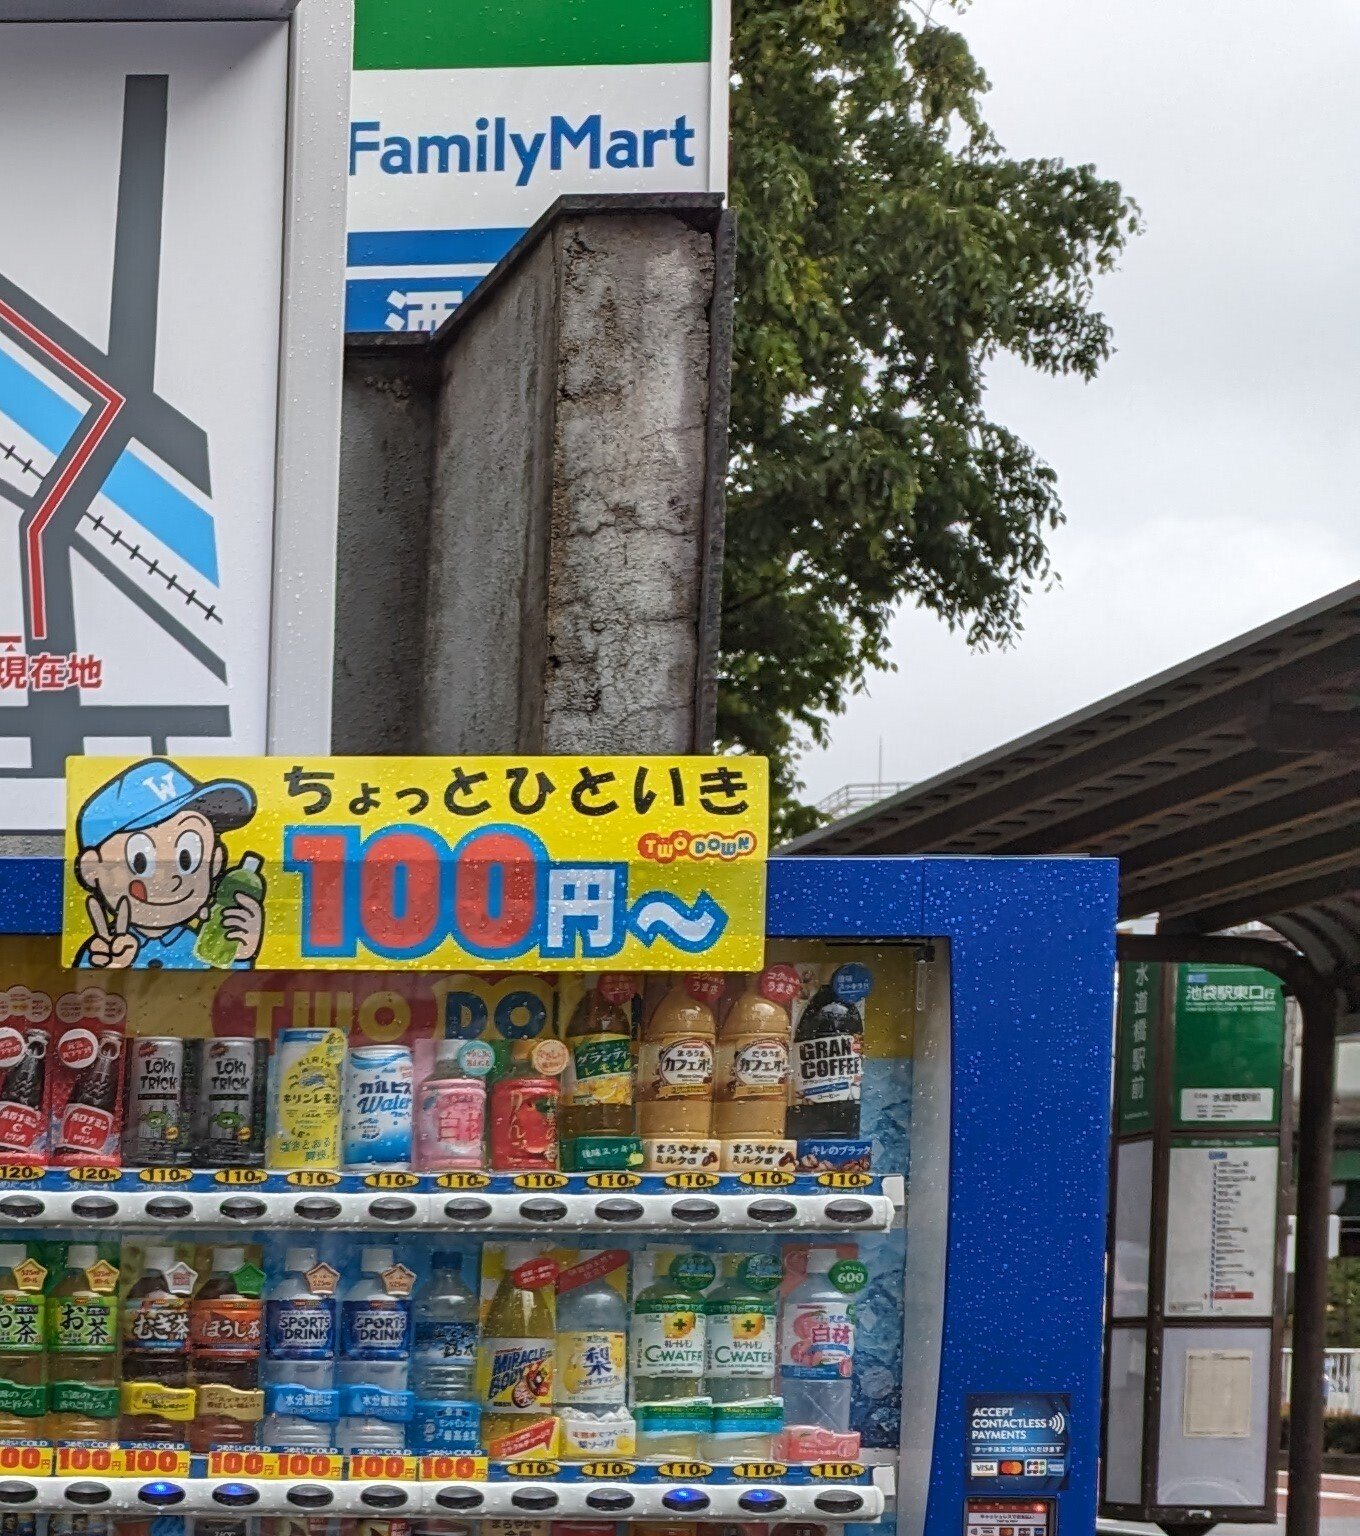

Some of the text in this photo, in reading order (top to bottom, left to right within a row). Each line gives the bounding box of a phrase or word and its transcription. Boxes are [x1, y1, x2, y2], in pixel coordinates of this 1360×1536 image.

[350, 115, 695, 186] FamilyMart
[284, 766, 748, 816] ちょっとひといき
[1186, 985, 1275, 1000] 池袋駅東口行
[800, 1035, 853, 1059] GRAN
[800, 1057, 862, 1079] COFFEE
[140, 1075, 178, 1091] TRICK
[837, 1272, 865, 1283] 600
[132, 1312, 190, 1340] むぎ茶
[202, 1319, 260, 1340] ほうじ茶
[279, 1316, 330, 1328] SPORTS
[284, 1328, 328, 1341] DRINK
[972, 1408, 1014, 1417] ACCEPT
[972, 1418, 1047, 1429] CONTACTLESS
[972, 1430, 1027, 1440] PAYMENTS
